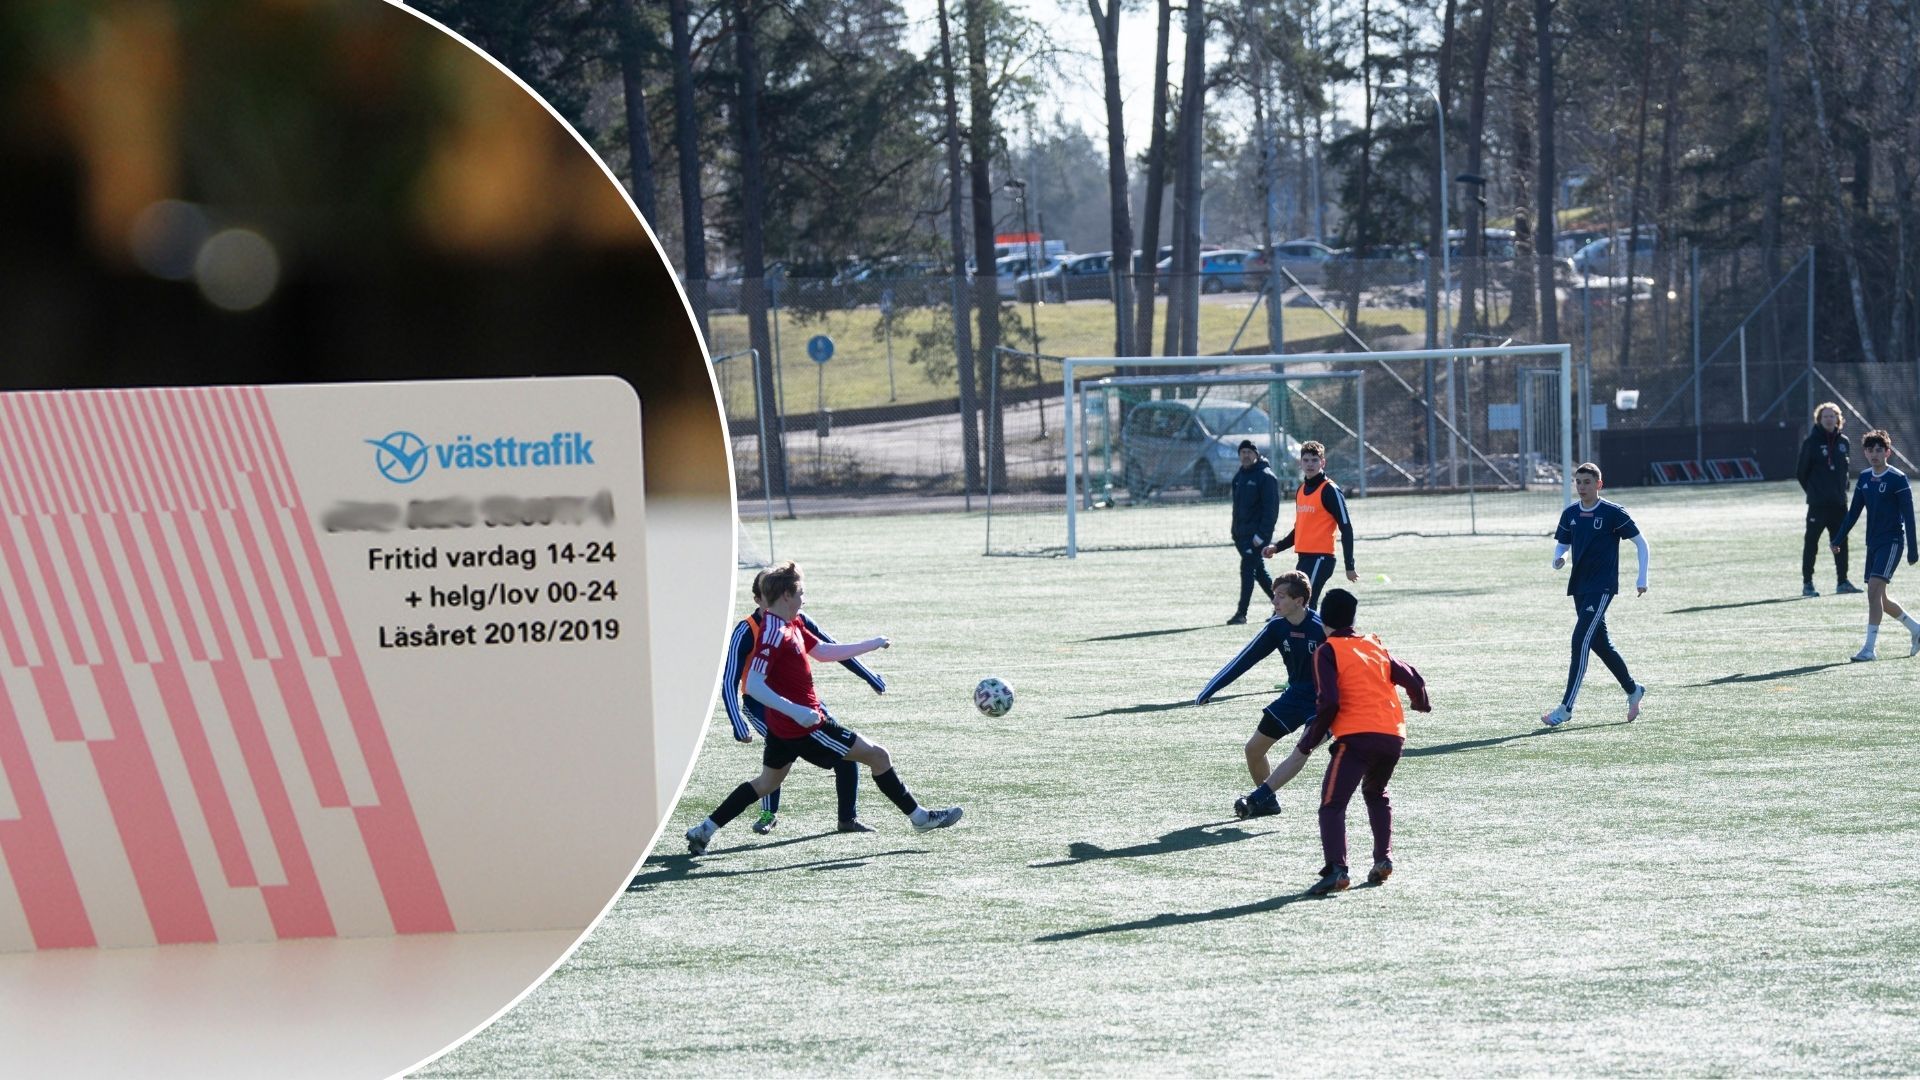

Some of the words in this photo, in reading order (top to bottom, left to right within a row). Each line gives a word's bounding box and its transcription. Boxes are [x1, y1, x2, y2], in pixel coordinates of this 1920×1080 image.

[435, 432, 595, 469] västtrafik
[368, 546, 438, 571] Fritid
[445, 544, 537, 570] vardag
[547, 541, 617, 565] 14-24
[429, 582, 540, 611] helg/lov
[547, 580, 619, 604] 00-24
[379, 623, 477, 649] Läsåret
[484, 618, 620, 645] 2018/2019
